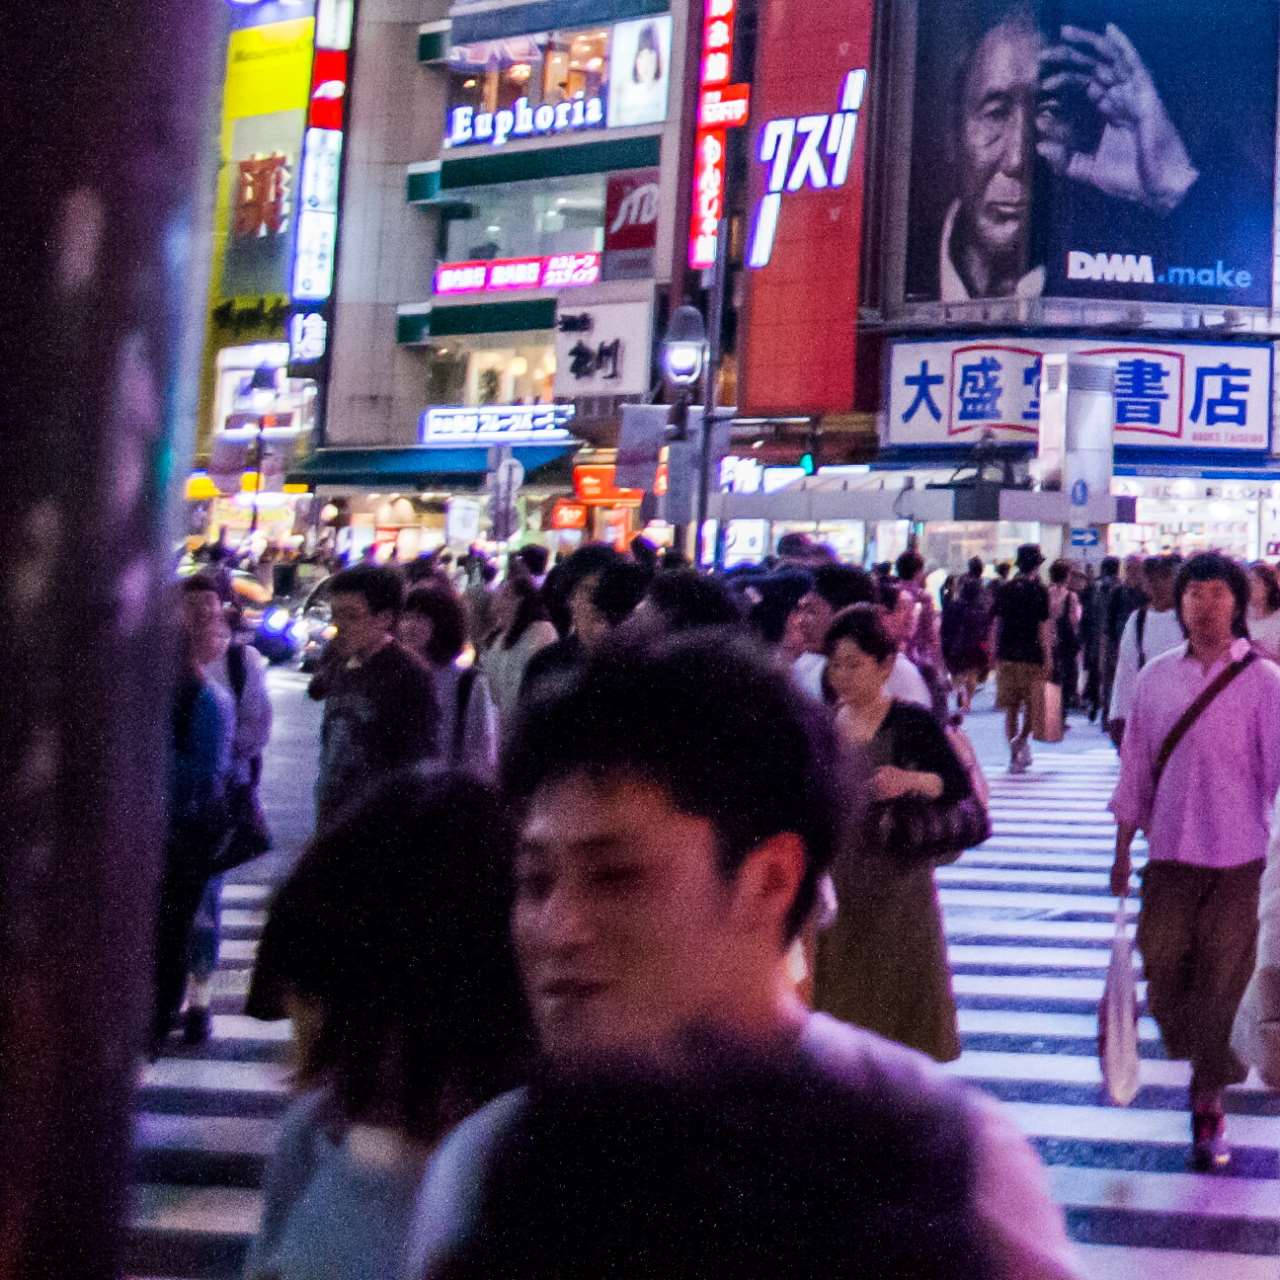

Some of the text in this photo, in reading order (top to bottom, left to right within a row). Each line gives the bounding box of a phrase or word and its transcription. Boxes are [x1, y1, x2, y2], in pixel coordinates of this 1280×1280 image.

[448, 90, 604, 146] Euphoria
[902, 355, 1253, 429] 大盛書店
